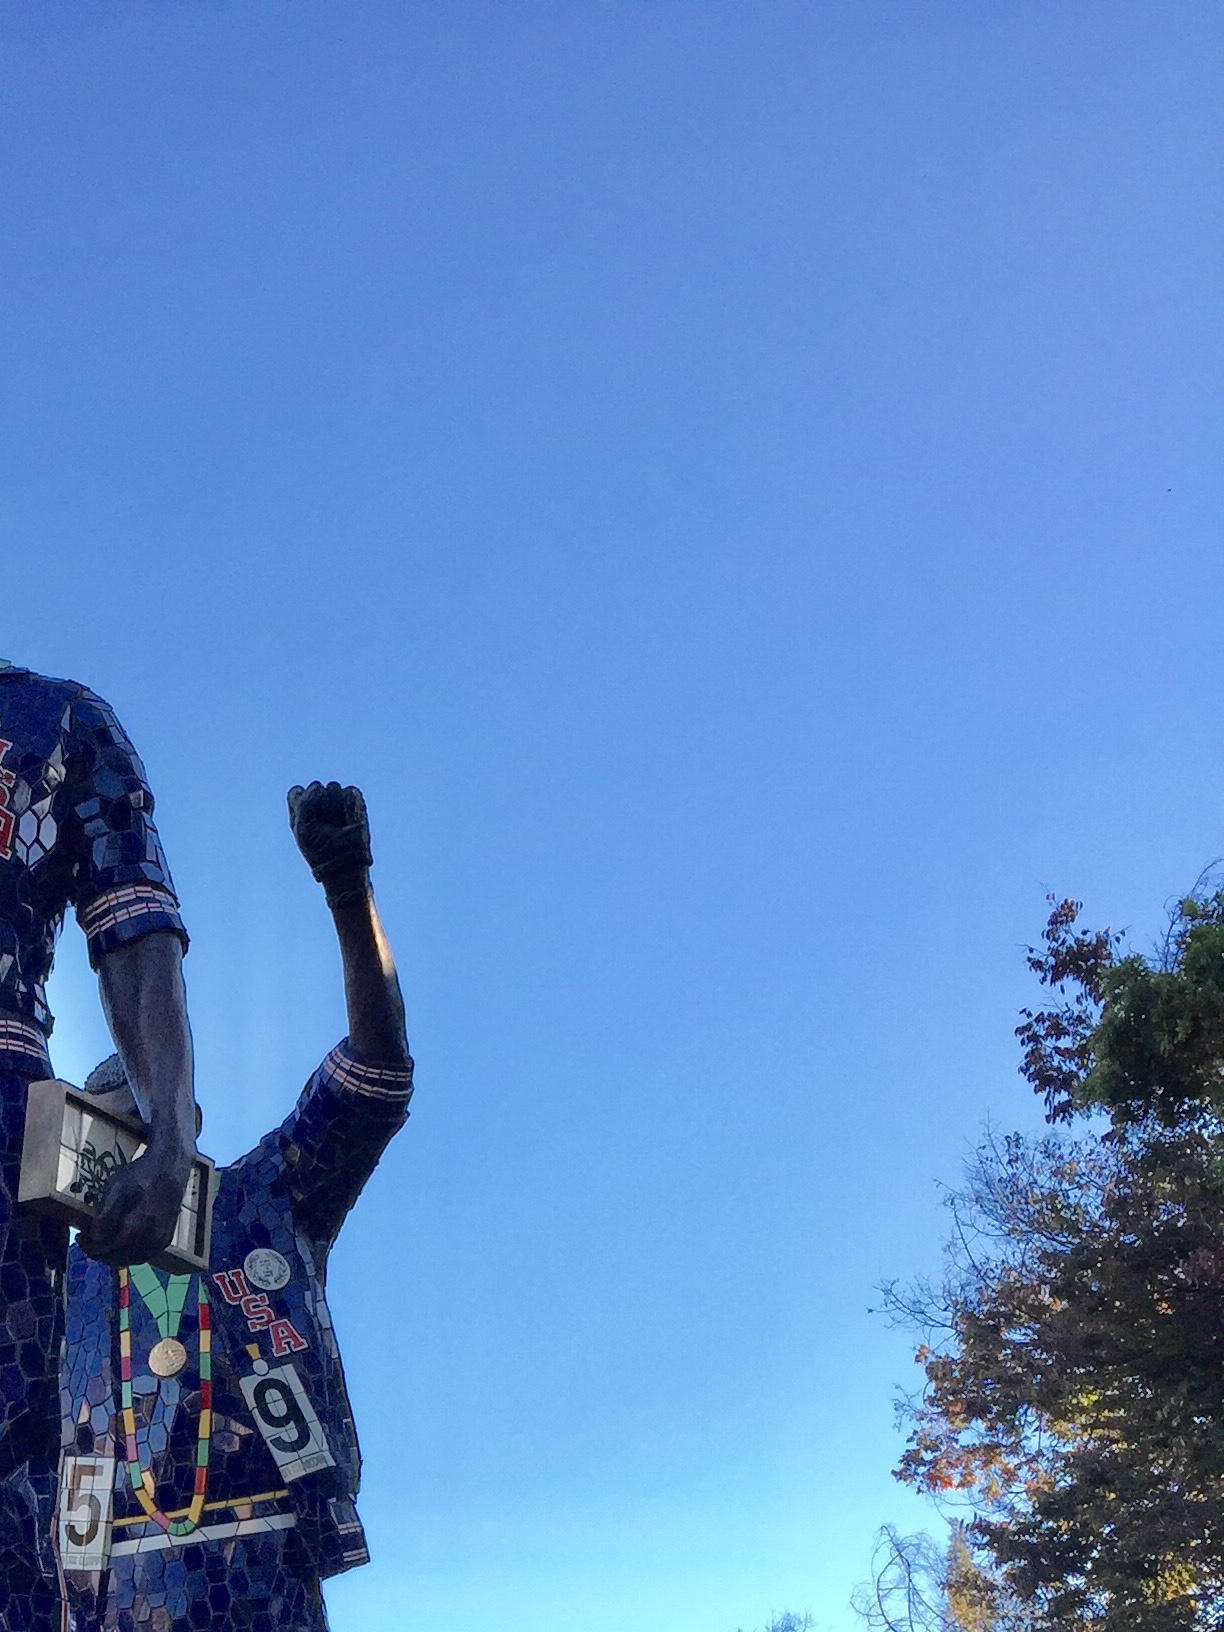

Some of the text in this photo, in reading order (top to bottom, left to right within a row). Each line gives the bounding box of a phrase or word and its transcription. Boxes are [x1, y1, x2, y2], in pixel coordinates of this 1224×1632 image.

[212, 1268, 309, 1358] USA
[253, 1377, 311, 1453] 9
[64, 1464, 104, 1547] 5
